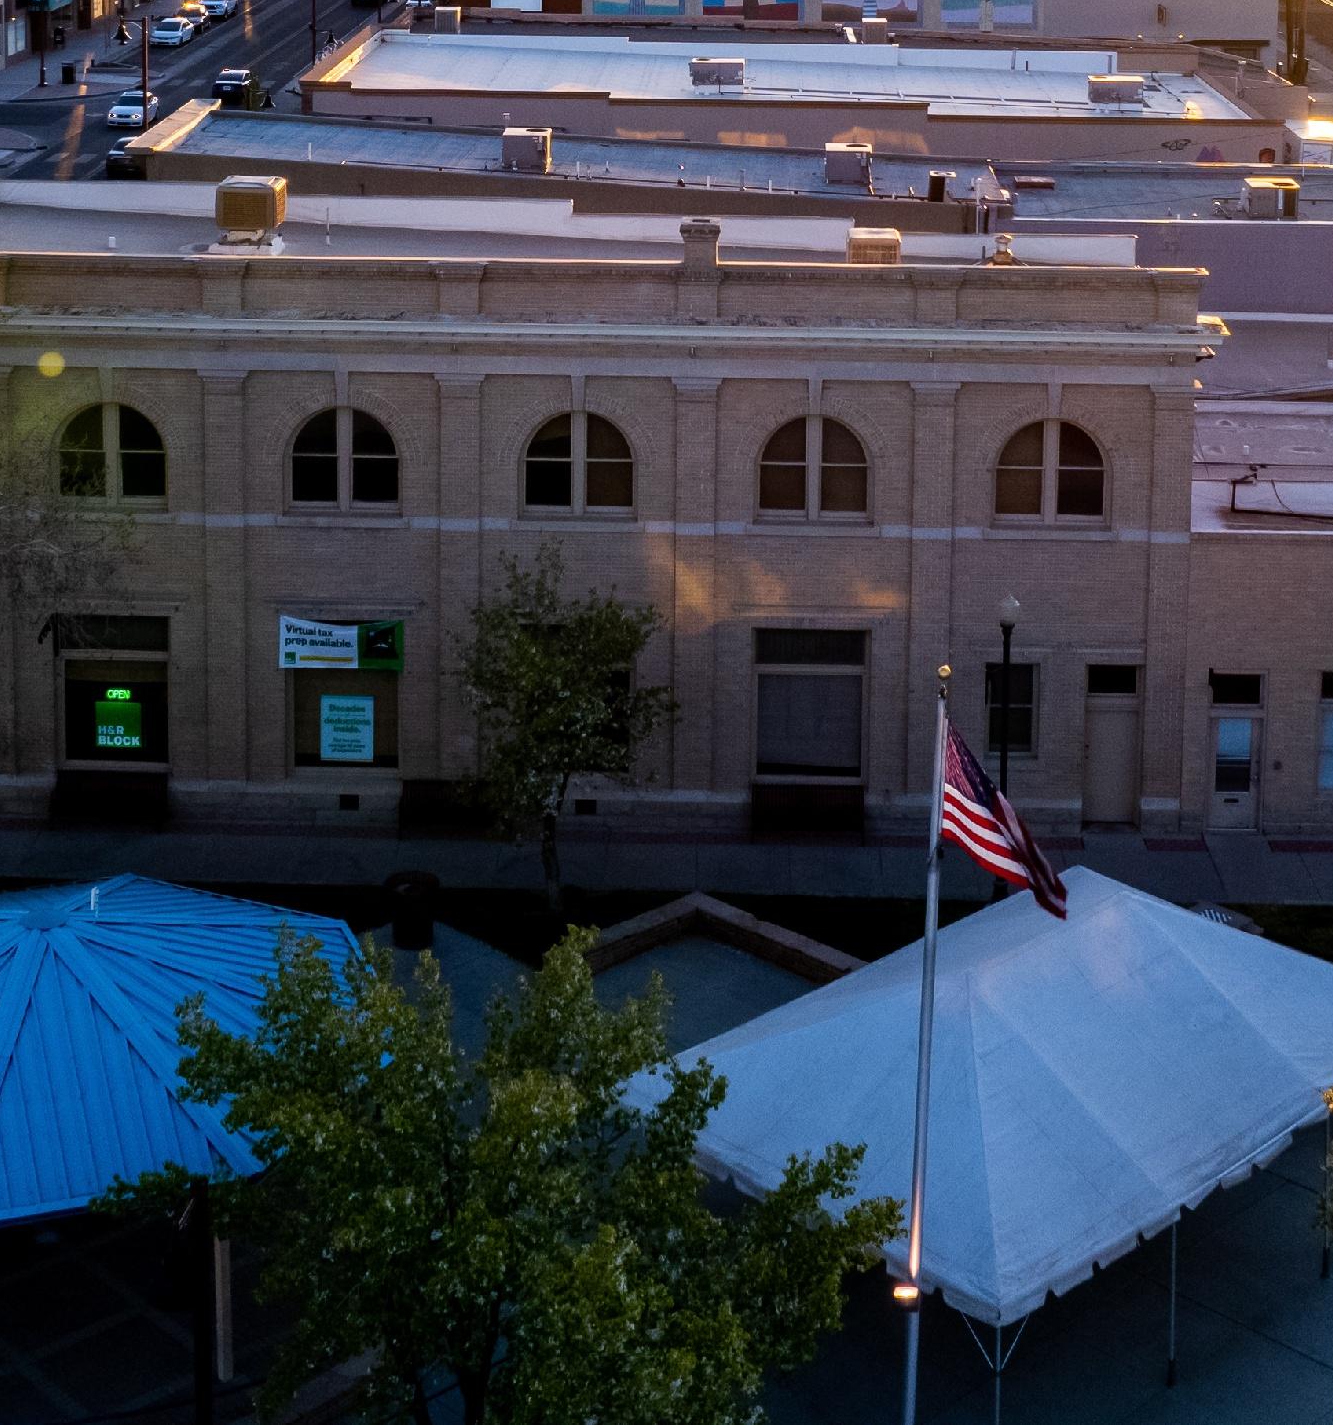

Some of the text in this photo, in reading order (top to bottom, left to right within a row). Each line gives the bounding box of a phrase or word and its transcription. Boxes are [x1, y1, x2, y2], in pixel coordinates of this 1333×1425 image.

[285, 624, 333, 637] Virtual tax
[284, 637, 354, 648] prep available.
[106, 689, 131, 700] OPEN
[97, 725, 124, 735] H&R
[97, 735, 140, 746] BLOCK
